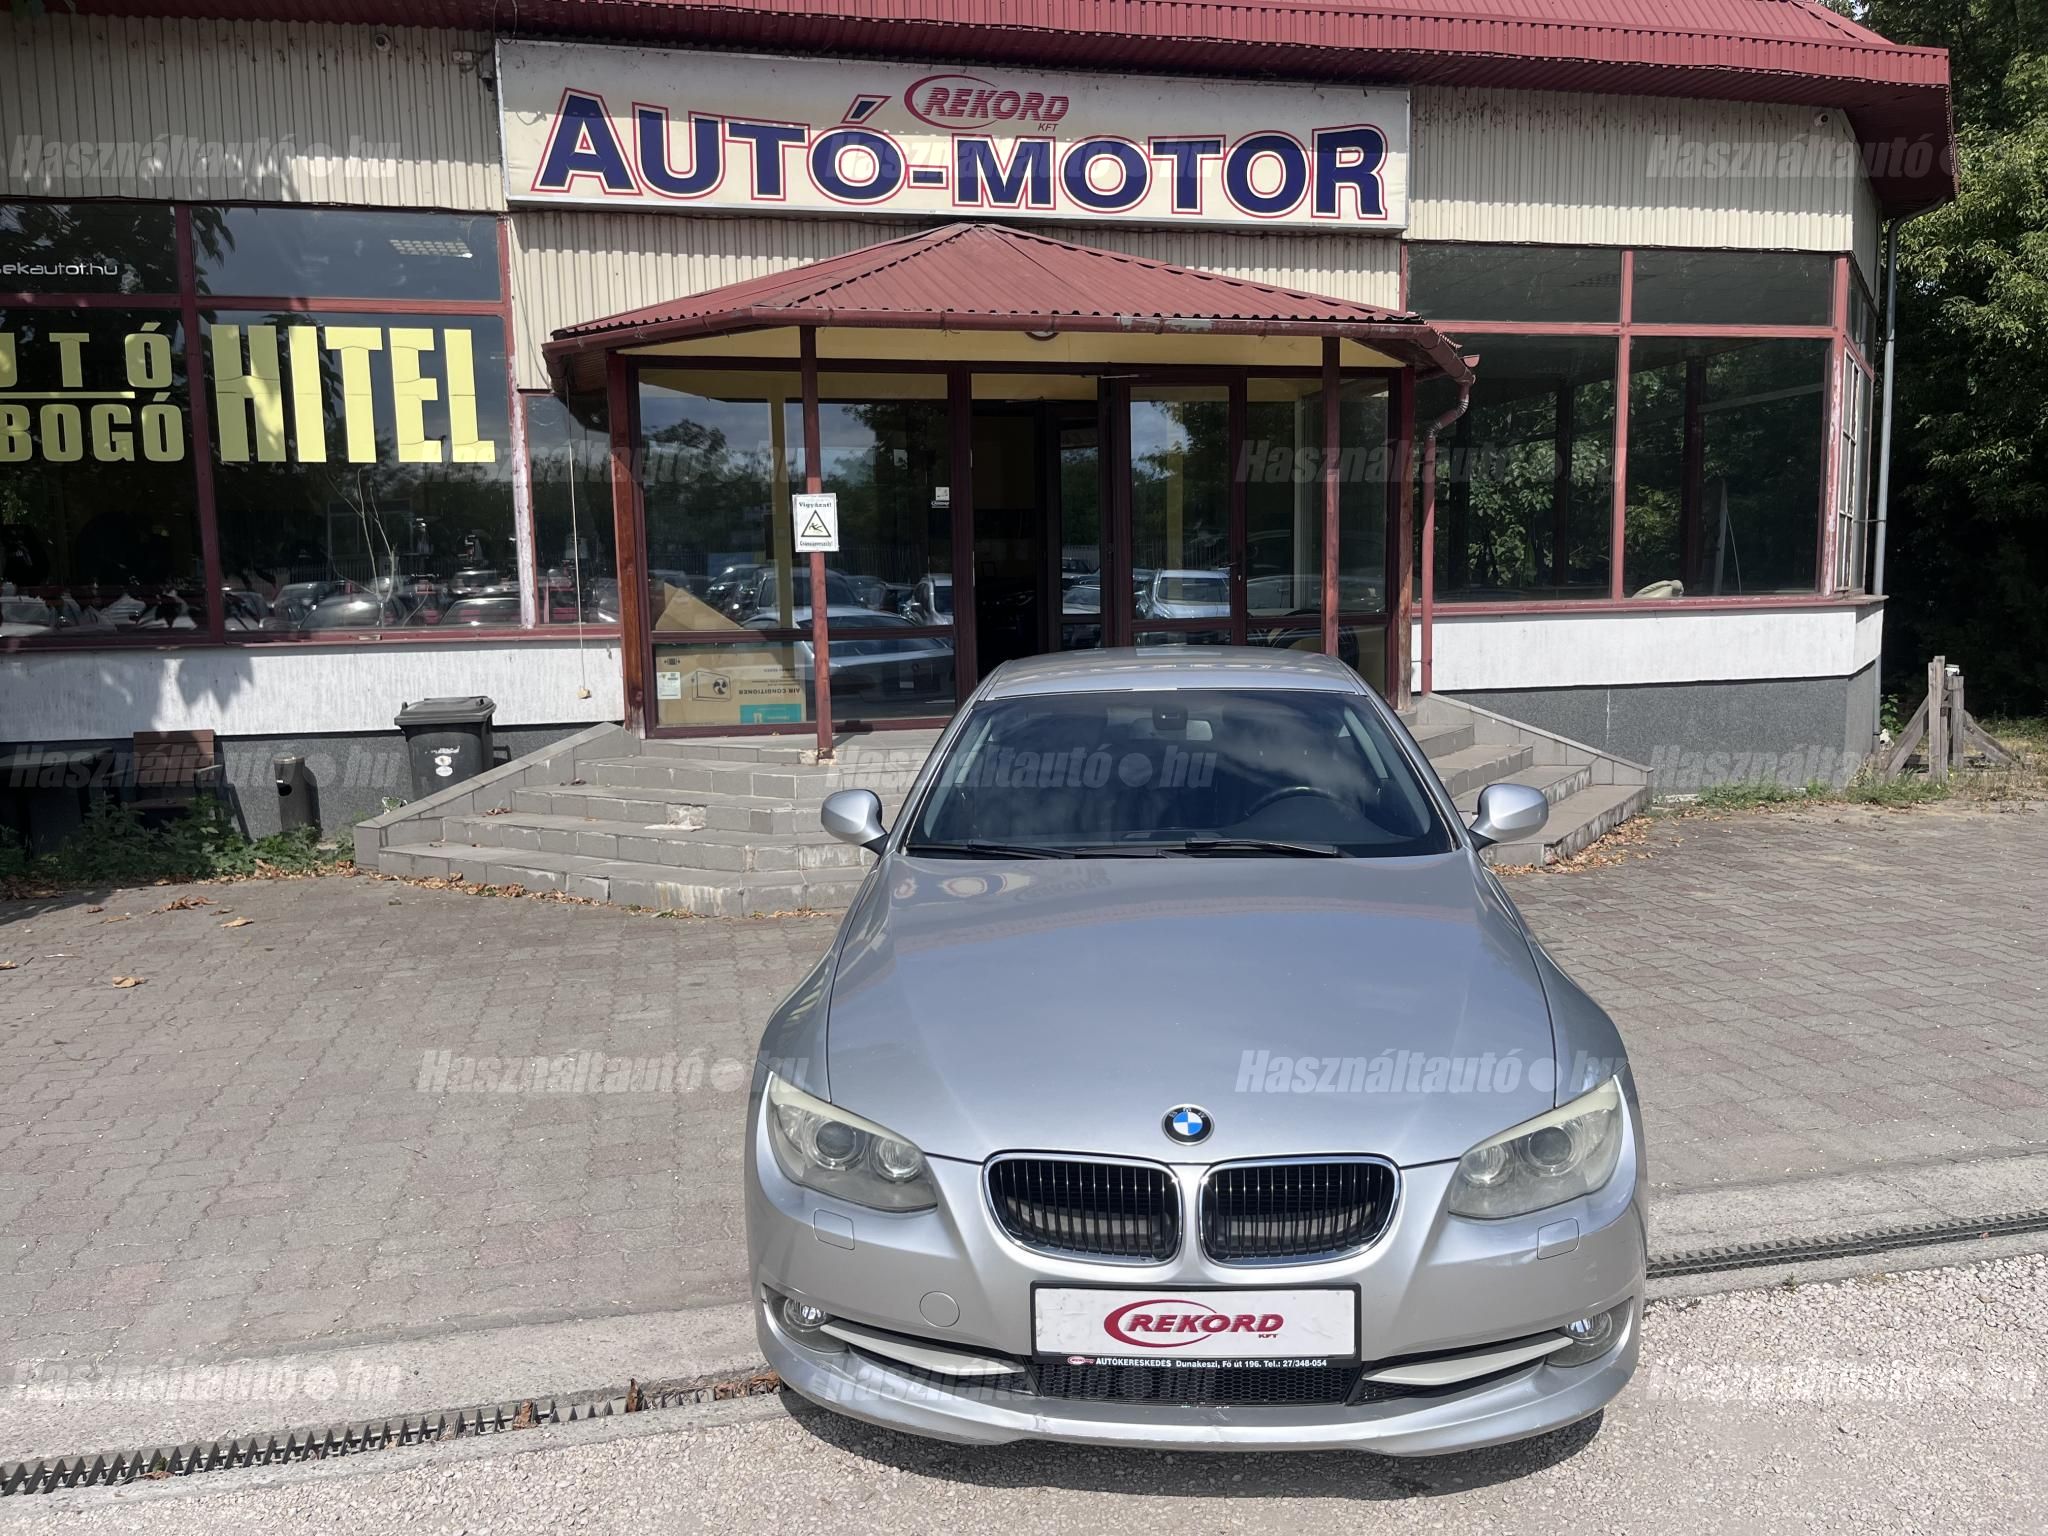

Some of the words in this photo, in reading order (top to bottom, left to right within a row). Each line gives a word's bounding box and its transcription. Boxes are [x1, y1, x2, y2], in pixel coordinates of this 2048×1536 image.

[922, 87, 1069, 122] REKORD
[1037, 122, 1059, 132] KFT
[531, 88, 1388, 220] AUTÓ-MOTOR
[0, 262, 118, 276] ekautot.hu
[210, 324, 496, 463] HITEL
[1126, 1313, 1284, 1333] REKORD
[1175, 1360, 1220, 1369] Dunakeszi,
[1245, 1360, 1262, 1368] 196.
[1263, 1360, 1281, 1368] Tel.:
[1282, 1359, 1327, 1367] 27/348-054
